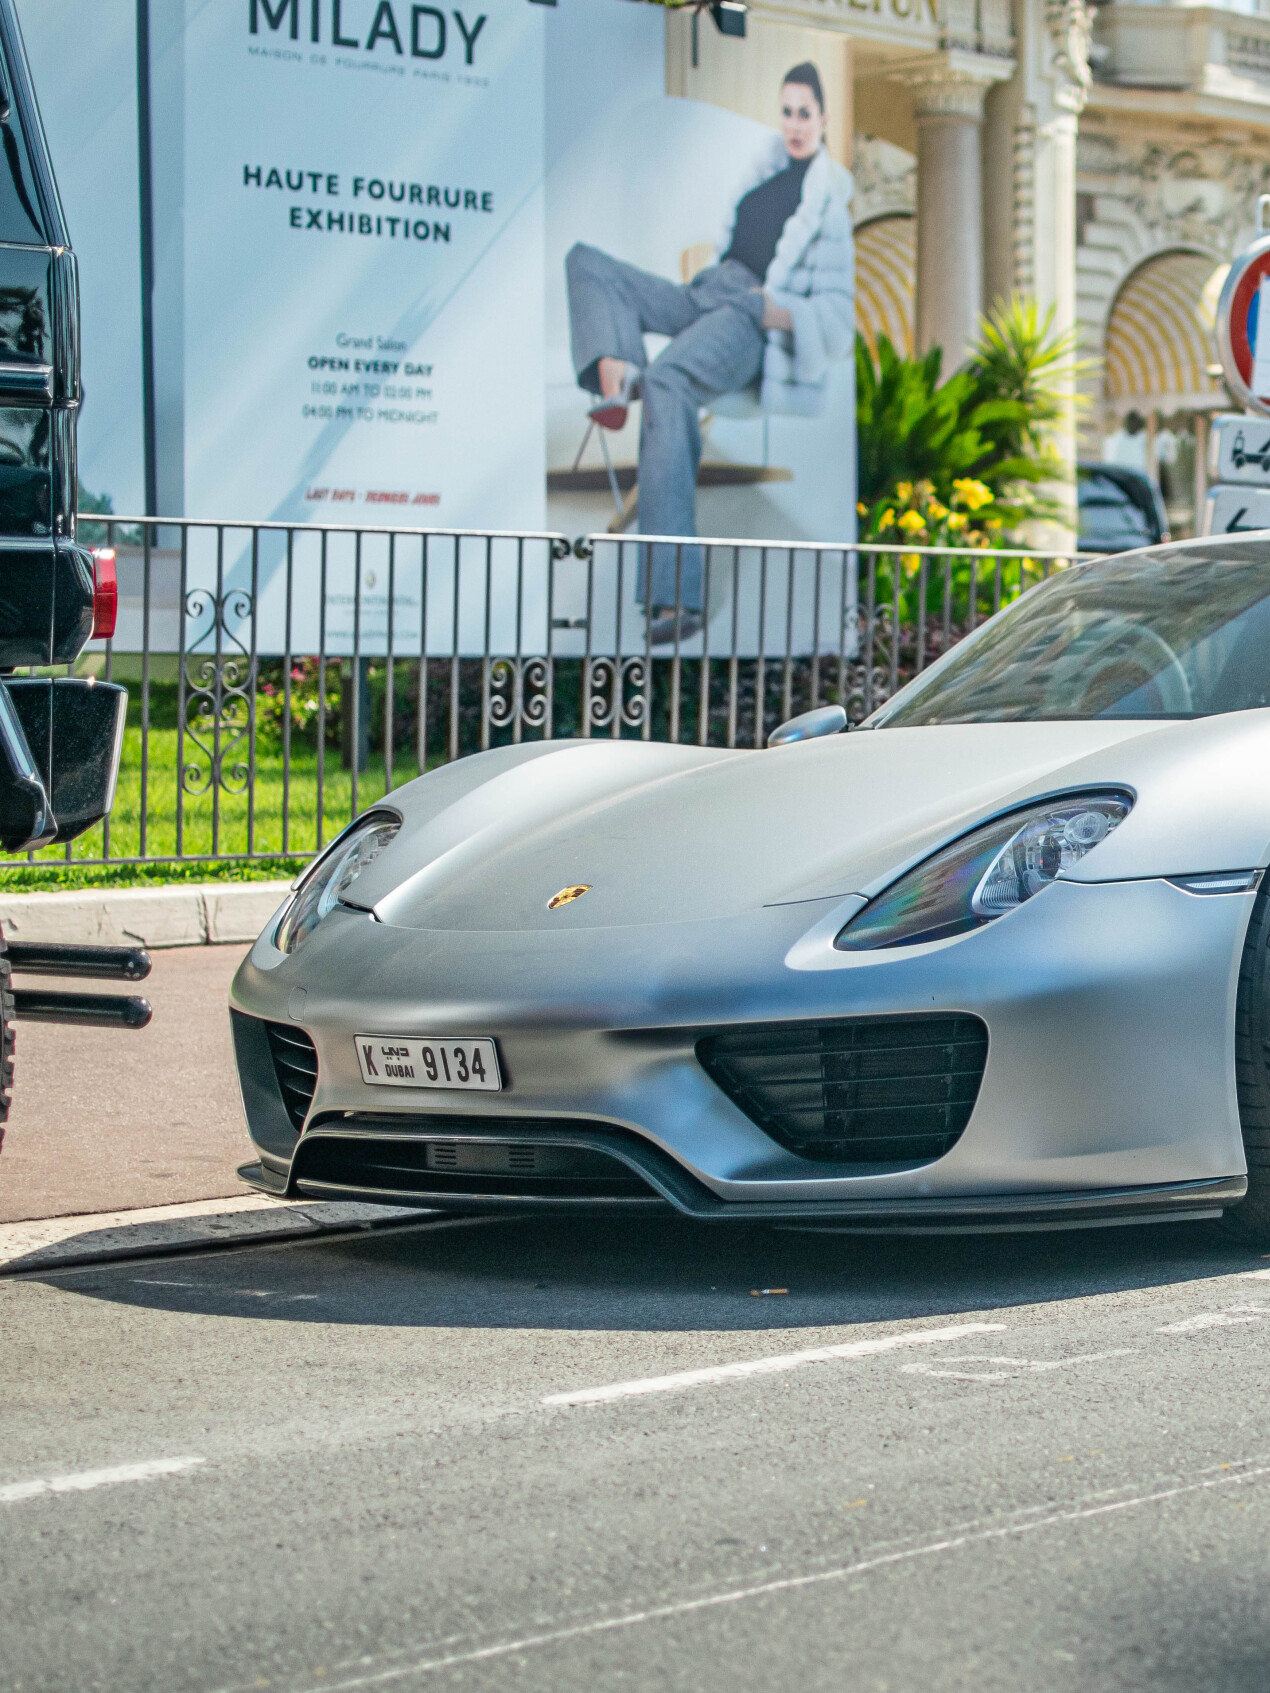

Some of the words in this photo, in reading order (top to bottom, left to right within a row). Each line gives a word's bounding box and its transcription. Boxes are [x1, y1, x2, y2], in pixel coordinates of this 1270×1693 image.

[249, 0, 487, 66] MILADY
[248, 46, 303, 62] MAISON
[310, 54, 327, 65] DE
[243, 164, 339, 196] HAUTE
[352, 176, 494, 213] FOURRURE
[289, 206, 452, 243] EXHIBITION
[336, 332, 373, 349] Grand
[307, 355, 349, 371] OPEN
[354, 358, 400, 375] EVERY
[404, 362, 434, 377] DAY
[341, 383, 360, 396] AM
[363, 383, 381, 398] TO
[416, 387, 432, 400] PM
[335, 405, 353, 419] PM
[357, 406, 375, 421] TO
[377, 408, 438, 424] MIDNIGHT
[362, 1044, 379, 1076] K
[384, 1063, 415, 1079] DUBAI
[421, 1046, 486, 1083] 9134
